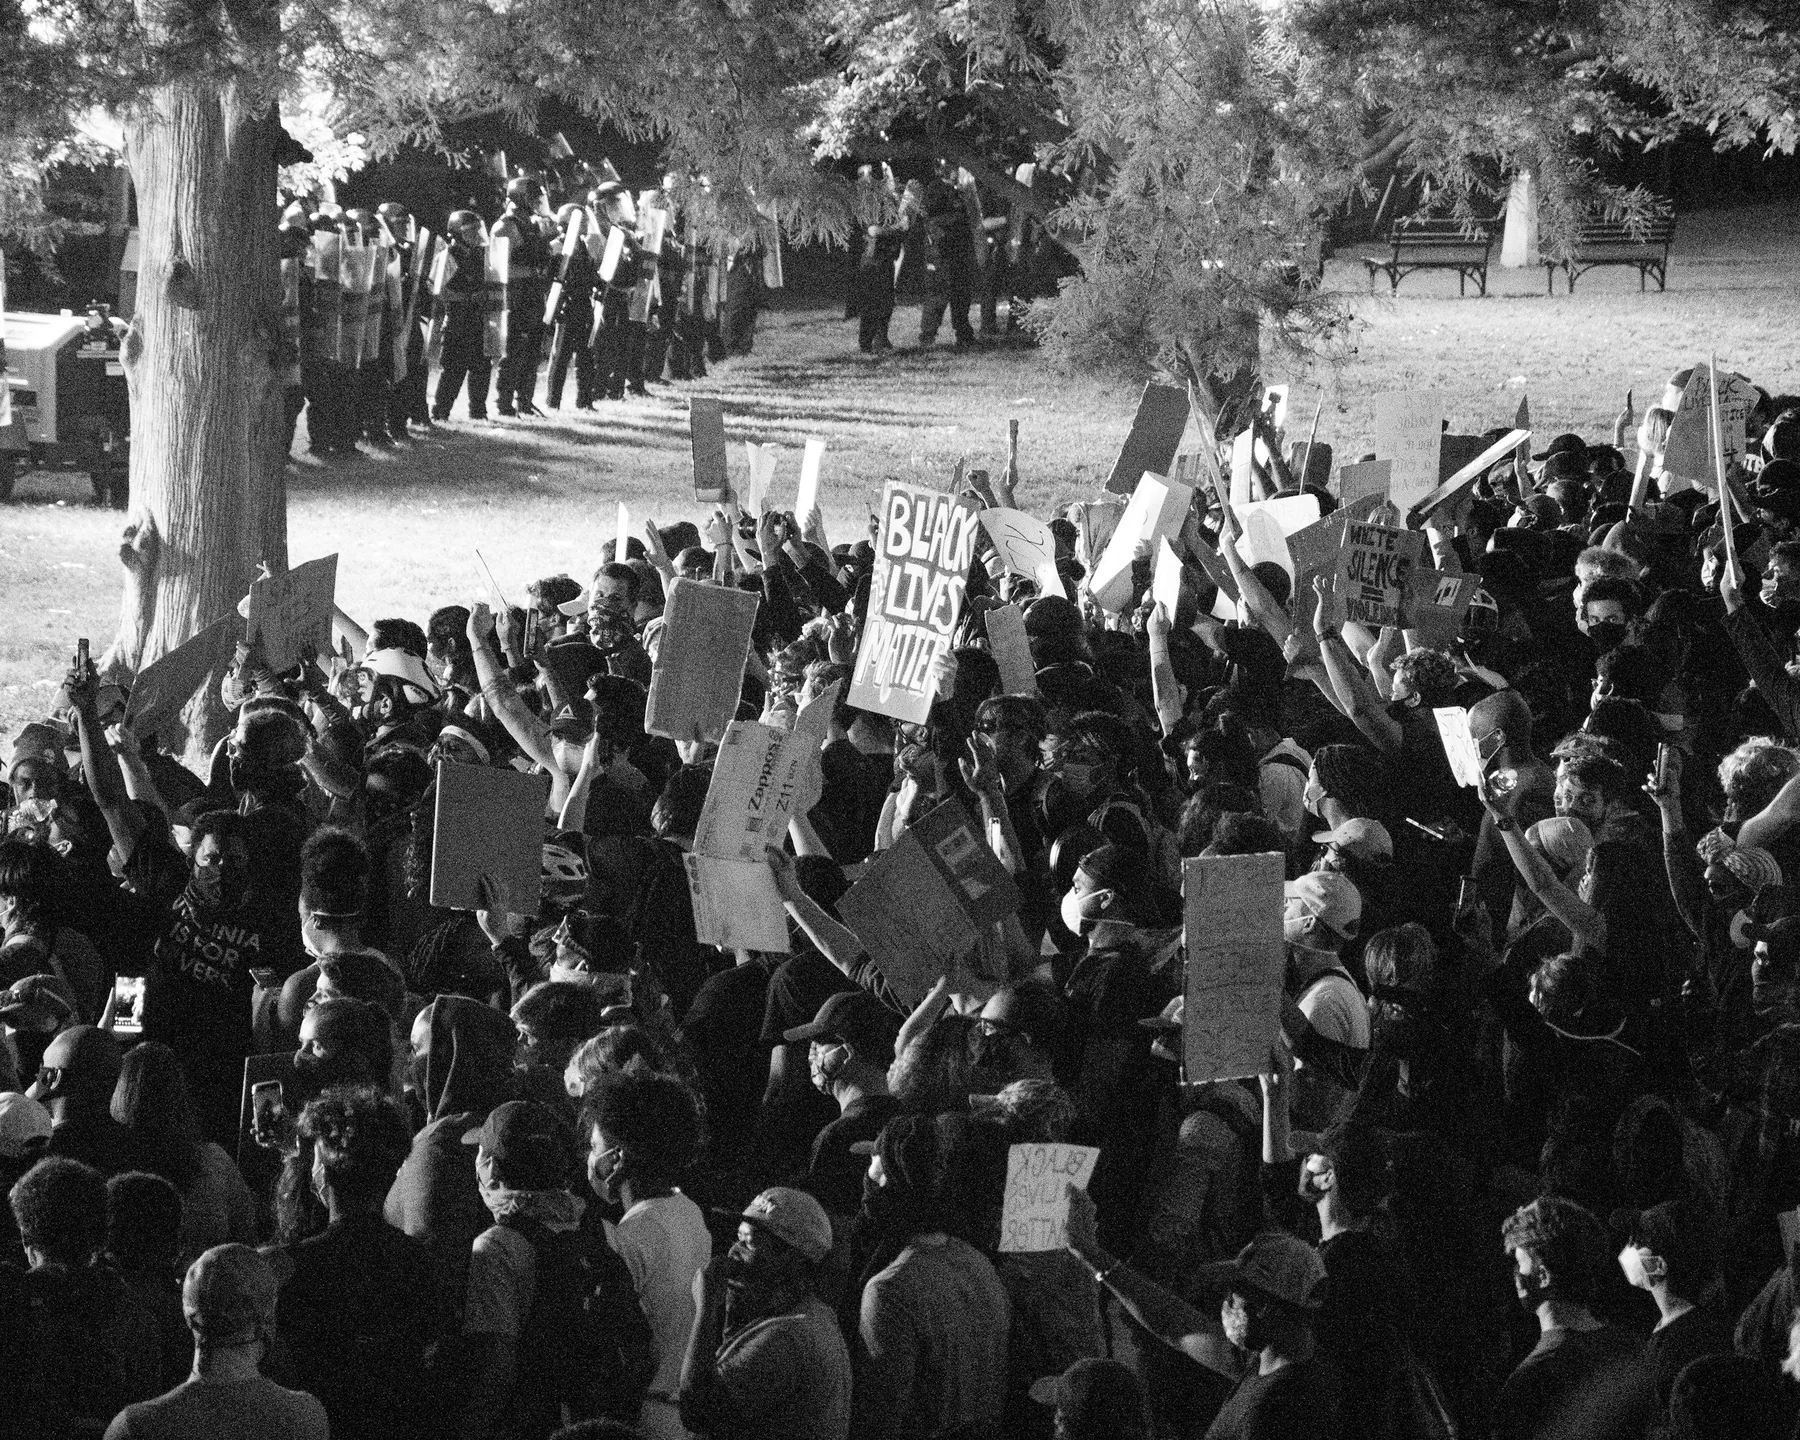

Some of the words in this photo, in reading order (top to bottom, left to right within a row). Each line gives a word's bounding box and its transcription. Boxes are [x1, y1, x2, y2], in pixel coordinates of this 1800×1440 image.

[886, 495, 979, 572] BLACK
[1350, 525, 1399, 551] WHITE
[1347, 551, 1411, 590] SILENCE
[885, 562, 966, 635] LIVES
[748, 742, 778, 810] Zappos
[775, 783, 795, 812] Z11
